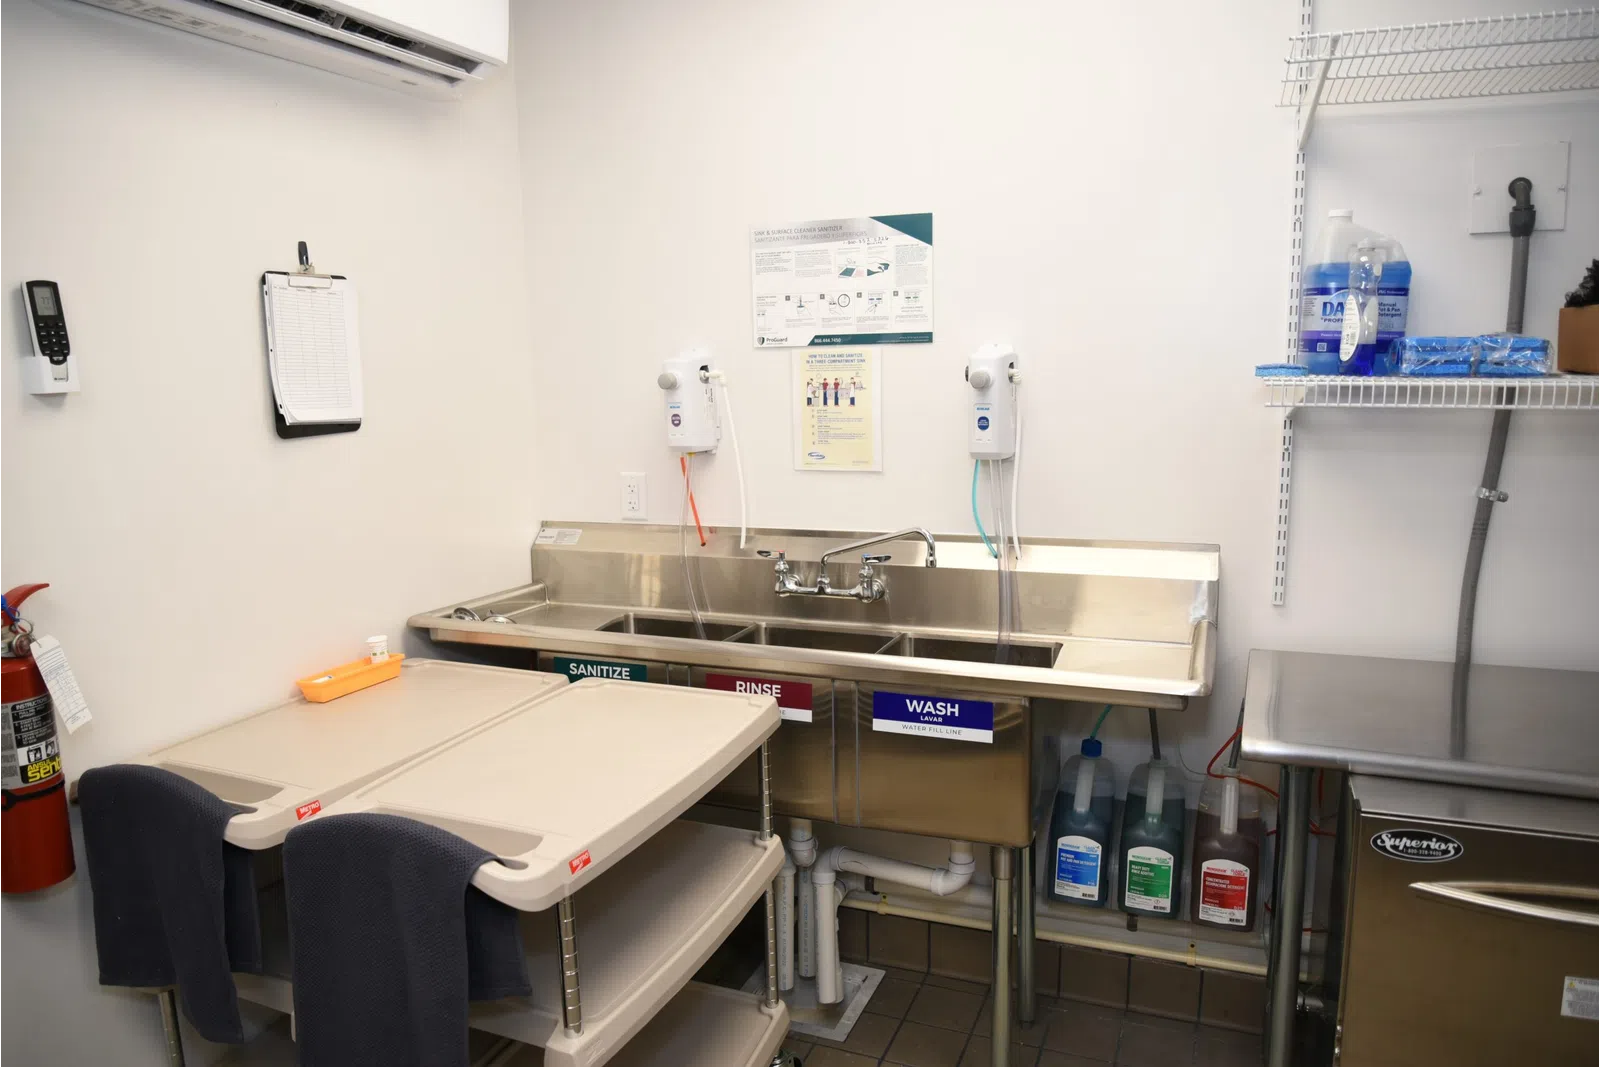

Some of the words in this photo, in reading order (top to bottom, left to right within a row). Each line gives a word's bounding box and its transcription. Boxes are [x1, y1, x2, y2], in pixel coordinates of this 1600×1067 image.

[1322, 302, 1345, 317] DA
[569, 662, 630, 680] SANITIZE
[736, 681, 782, 698] RINSE
[906, 699, 959, 717] WASH
[1377, 833, 1457, 856] Superior
